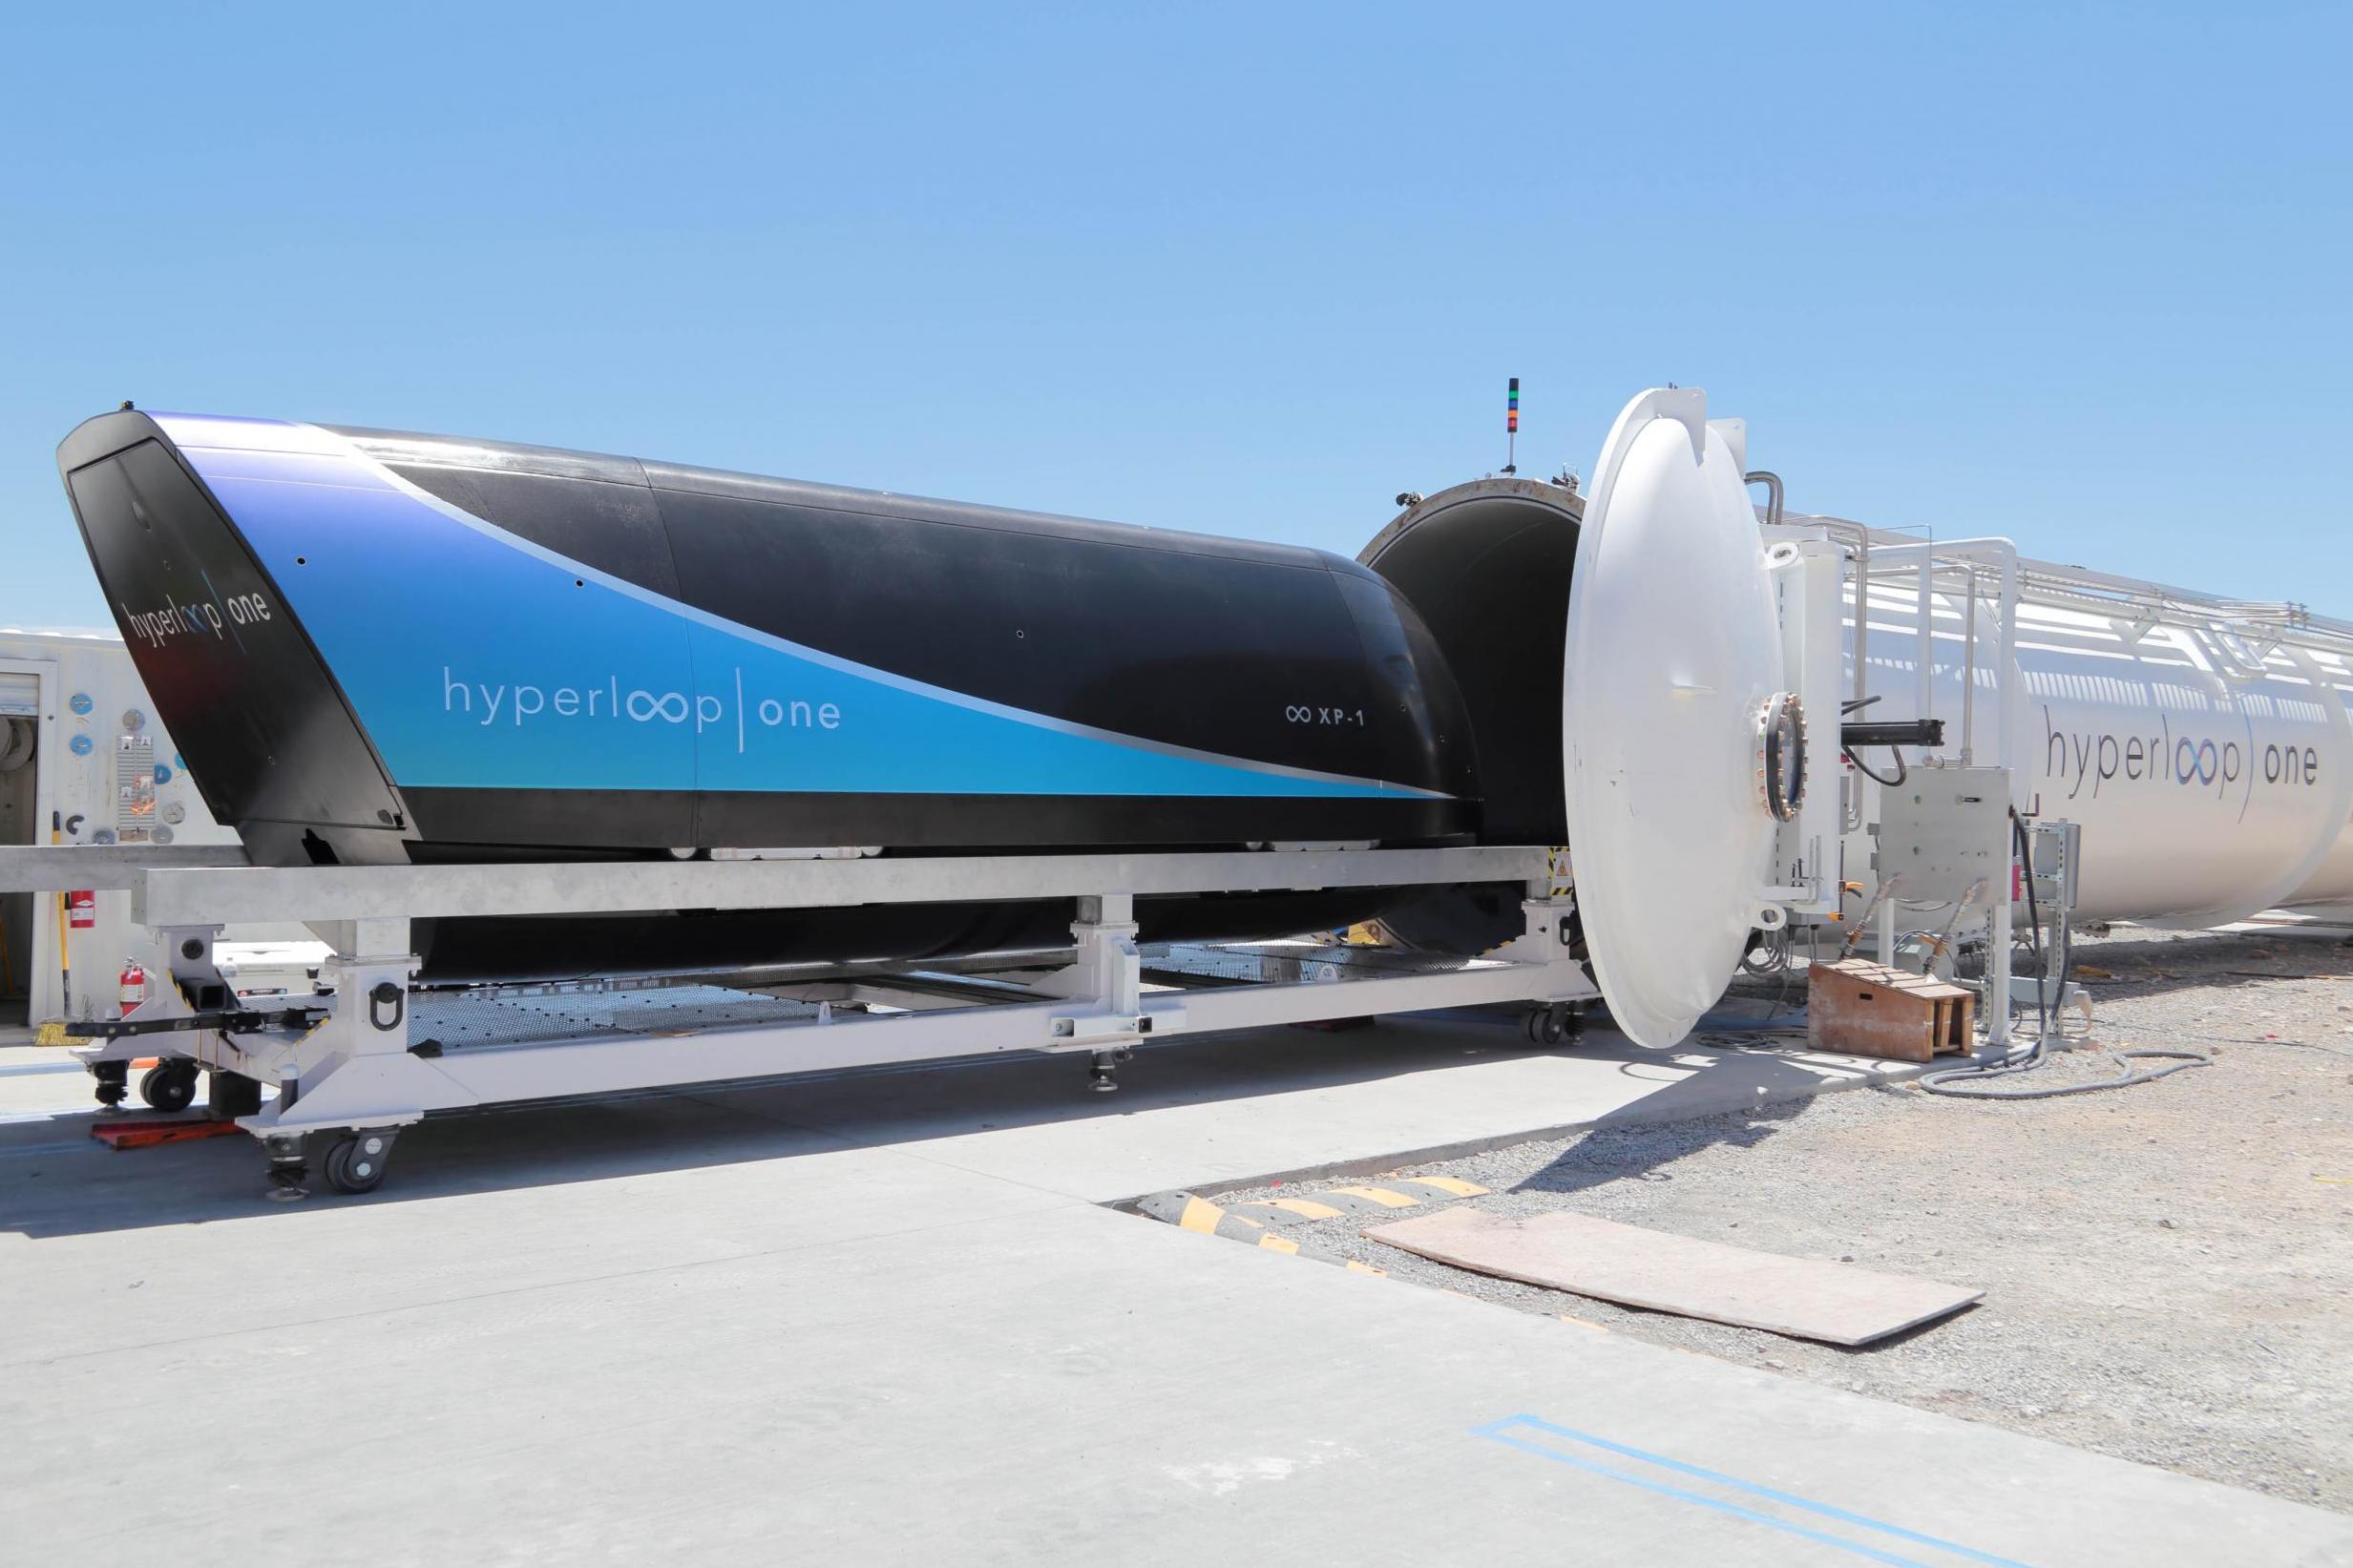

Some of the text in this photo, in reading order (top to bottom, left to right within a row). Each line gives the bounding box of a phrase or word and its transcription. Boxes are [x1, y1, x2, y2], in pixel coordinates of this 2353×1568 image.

[121, 592, 271, 649] hyperloop one
[443, 666, 842, 734] hyperloop one
[1317, 707, 1364, 726] XP-1
[2044, 704, 2318, 800] hyperloop one
